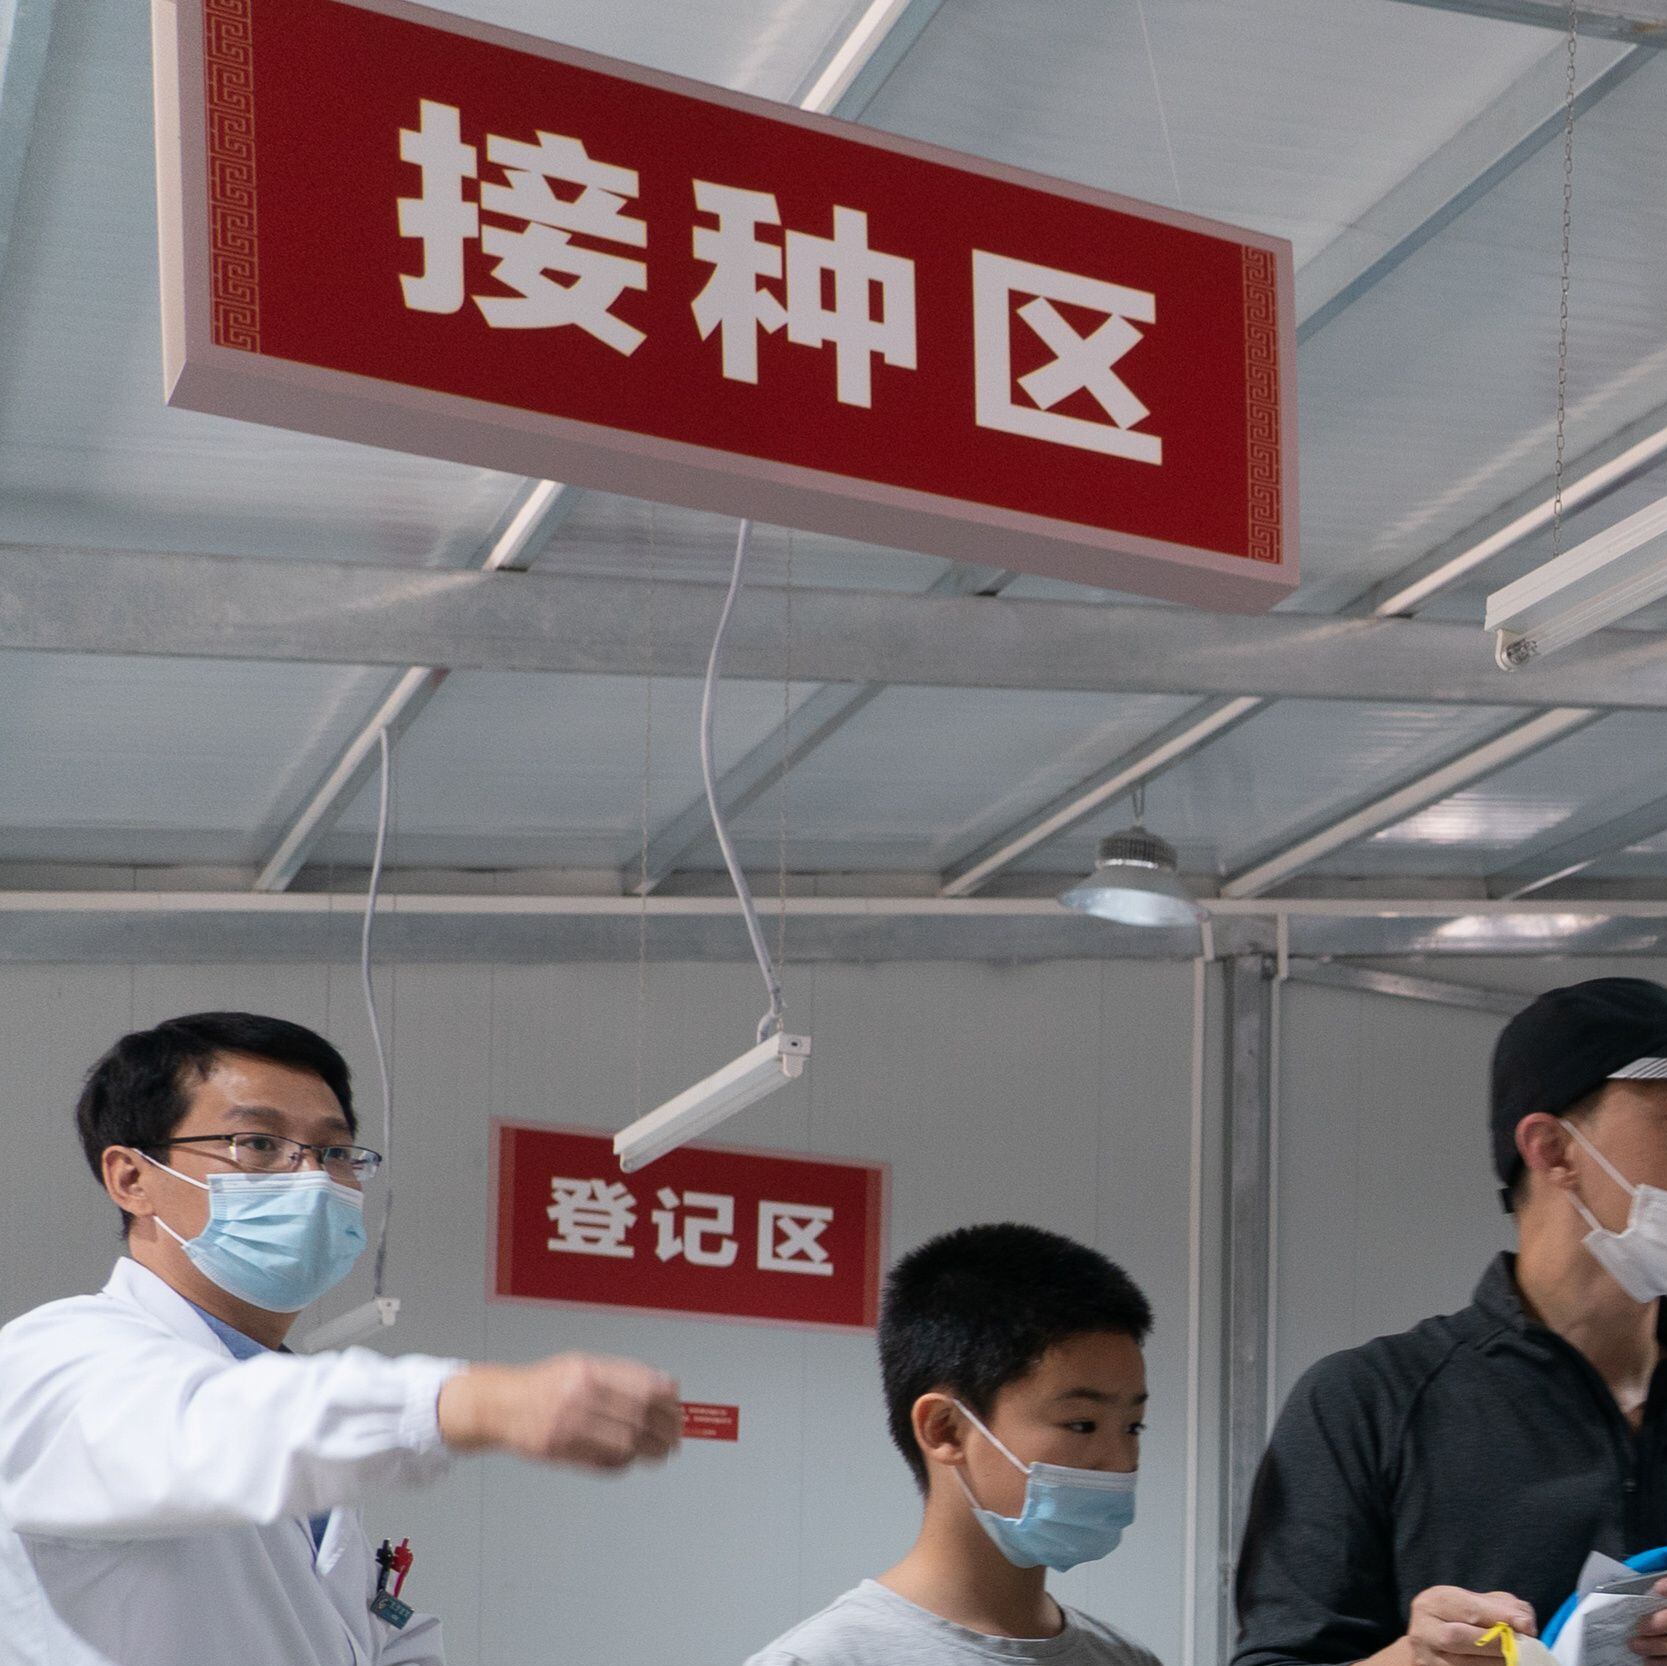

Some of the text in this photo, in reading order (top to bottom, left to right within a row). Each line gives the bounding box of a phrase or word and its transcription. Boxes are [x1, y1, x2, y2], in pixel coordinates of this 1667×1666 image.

[396, 98, 1163, 467] 接种区
[546, 1177, 834, 1276] 登记区
